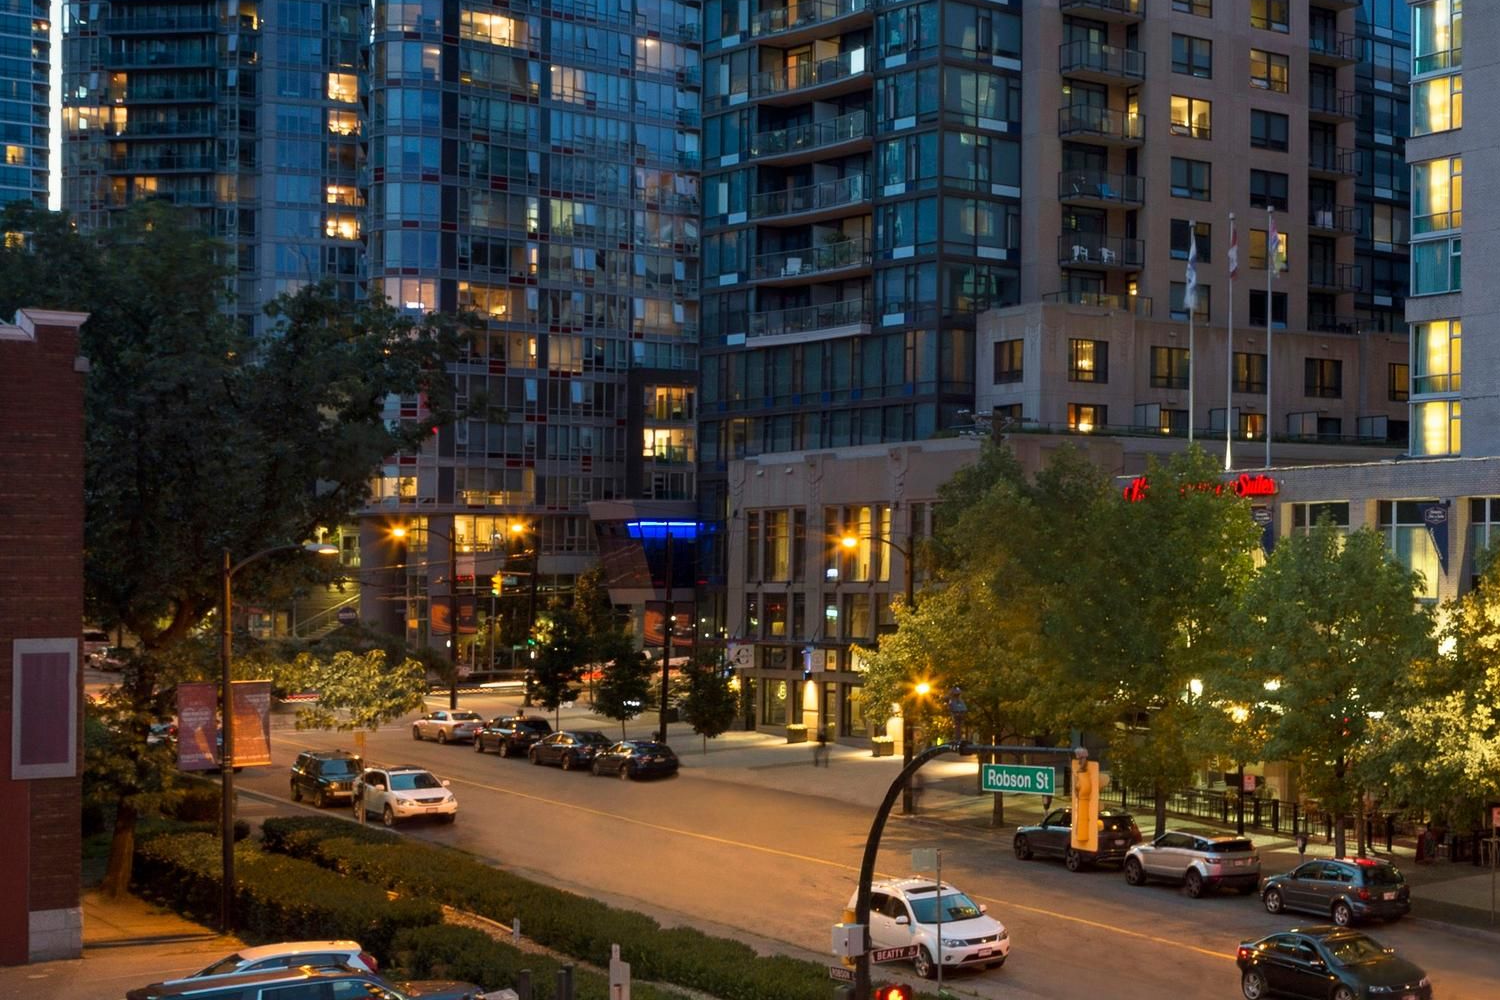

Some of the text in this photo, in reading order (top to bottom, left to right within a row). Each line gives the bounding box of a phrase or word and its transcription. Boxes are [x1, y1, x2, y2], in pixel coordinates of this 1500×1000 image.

[1237, 473, 1275, 497] Suites
[988, 769, 1049, 789] Robson St
[877, 948, 905, 961] BEATTY
